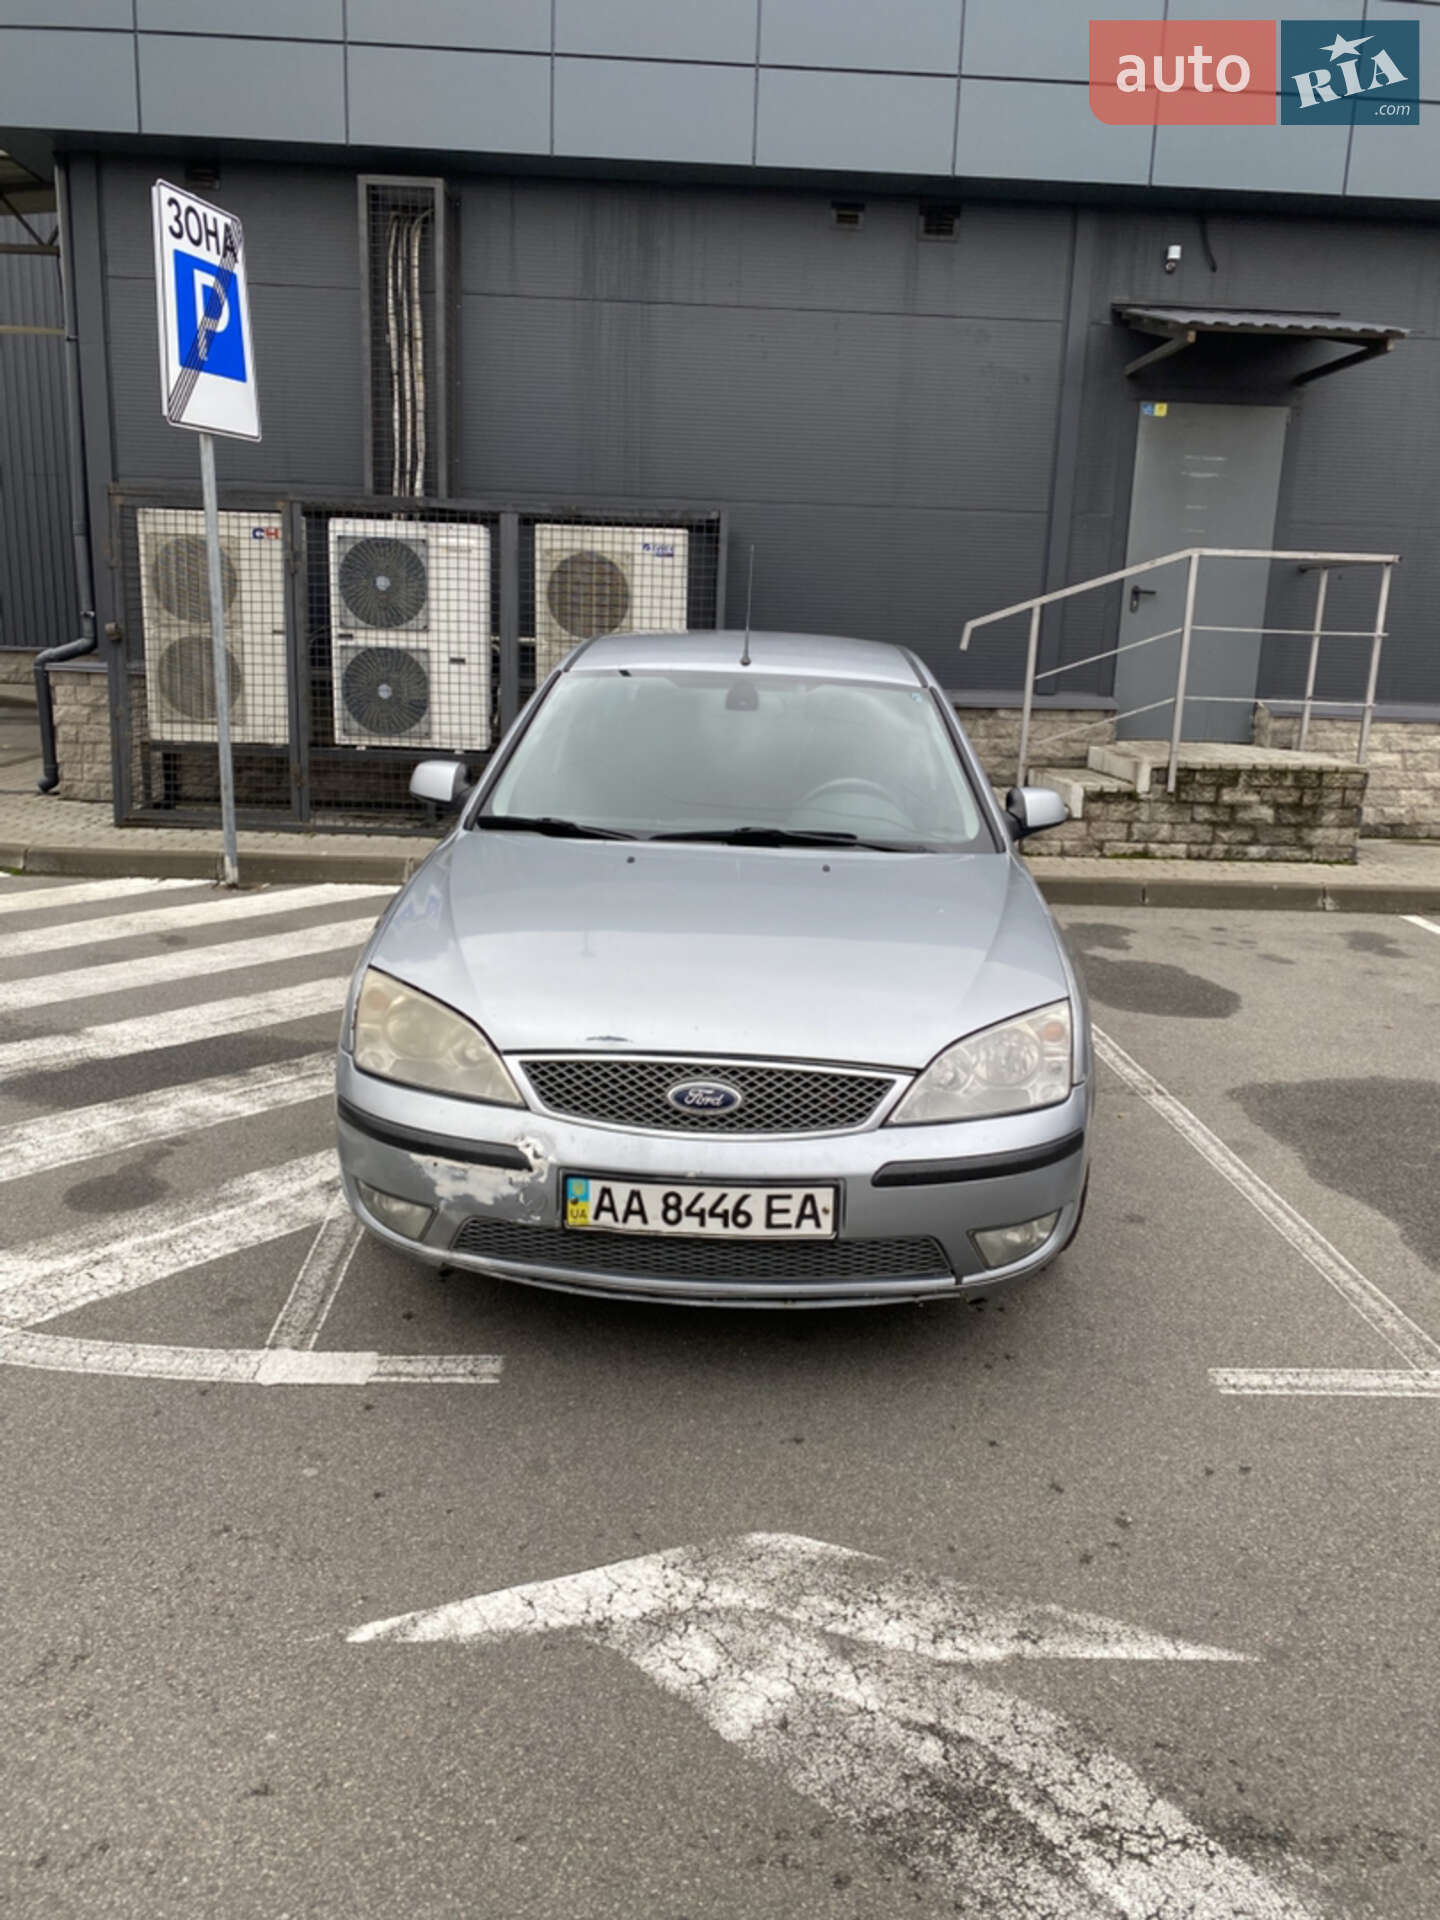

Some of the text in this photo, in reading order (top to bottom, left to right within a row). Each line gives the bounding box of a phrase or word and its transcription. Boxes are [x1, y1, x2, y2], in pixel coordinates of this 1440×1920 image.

[167, 197, 239, 263] ЗОНА
[684, 1088, 724, 1106] Ford
[593, 1186, 821, 1229] AA 8446 EA
